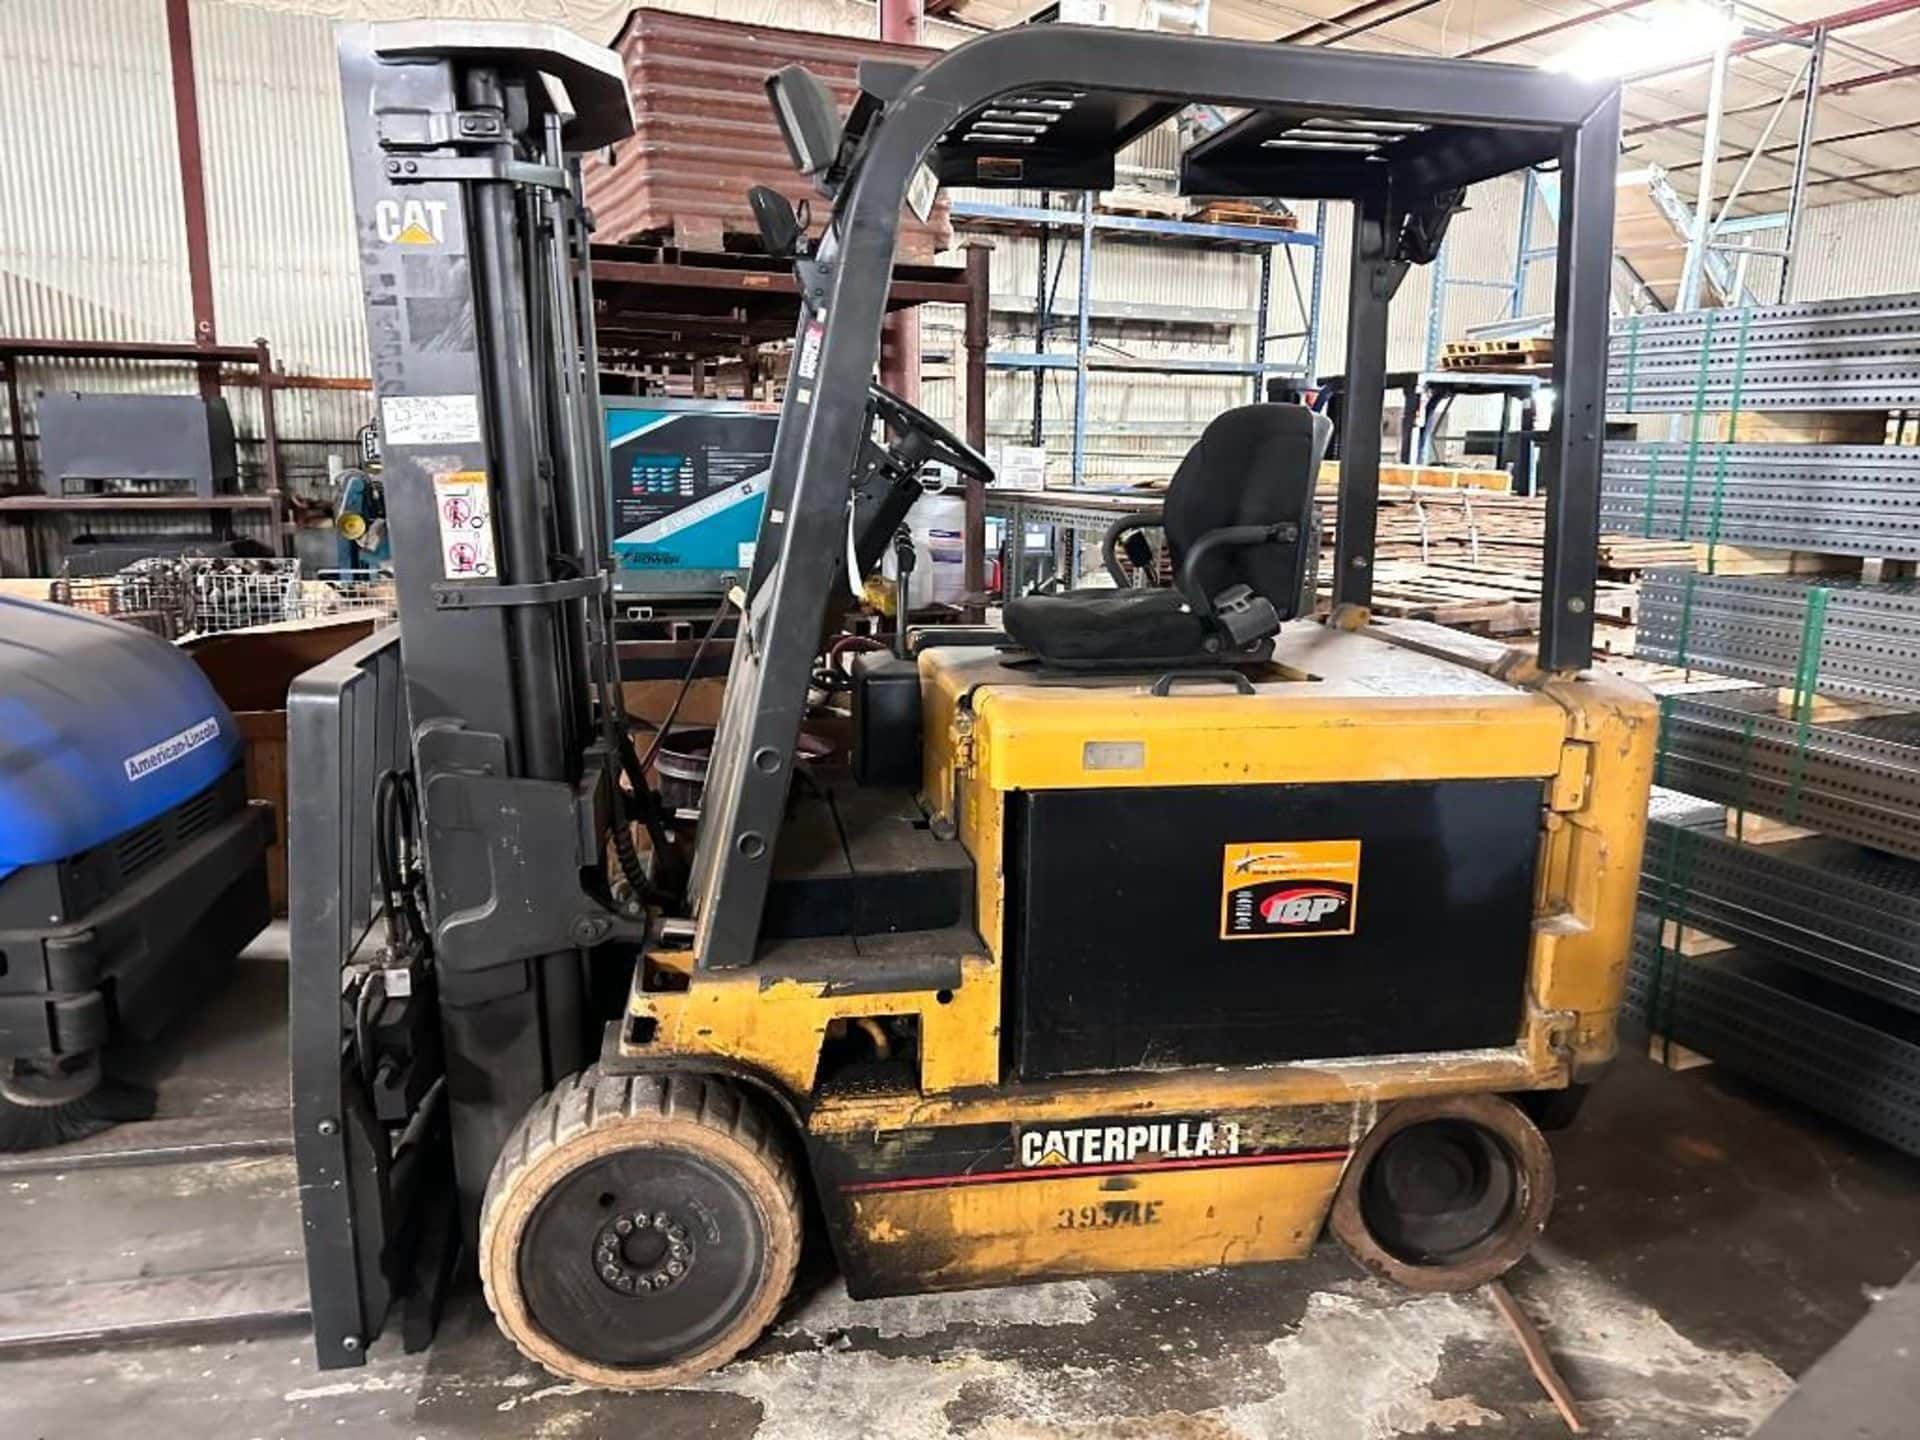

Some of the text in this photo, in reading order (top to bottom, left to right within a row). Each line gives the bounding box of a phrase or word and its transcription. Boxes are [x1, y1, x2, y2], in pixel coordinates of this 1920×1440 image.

[375, 199, 448, 244] CAT
[129, 722, 216, 777] American-Lincoln
[1266, 897, 1340, 924] IBP
[1021, 1121, 1240, 1168] CATERPILLAR
